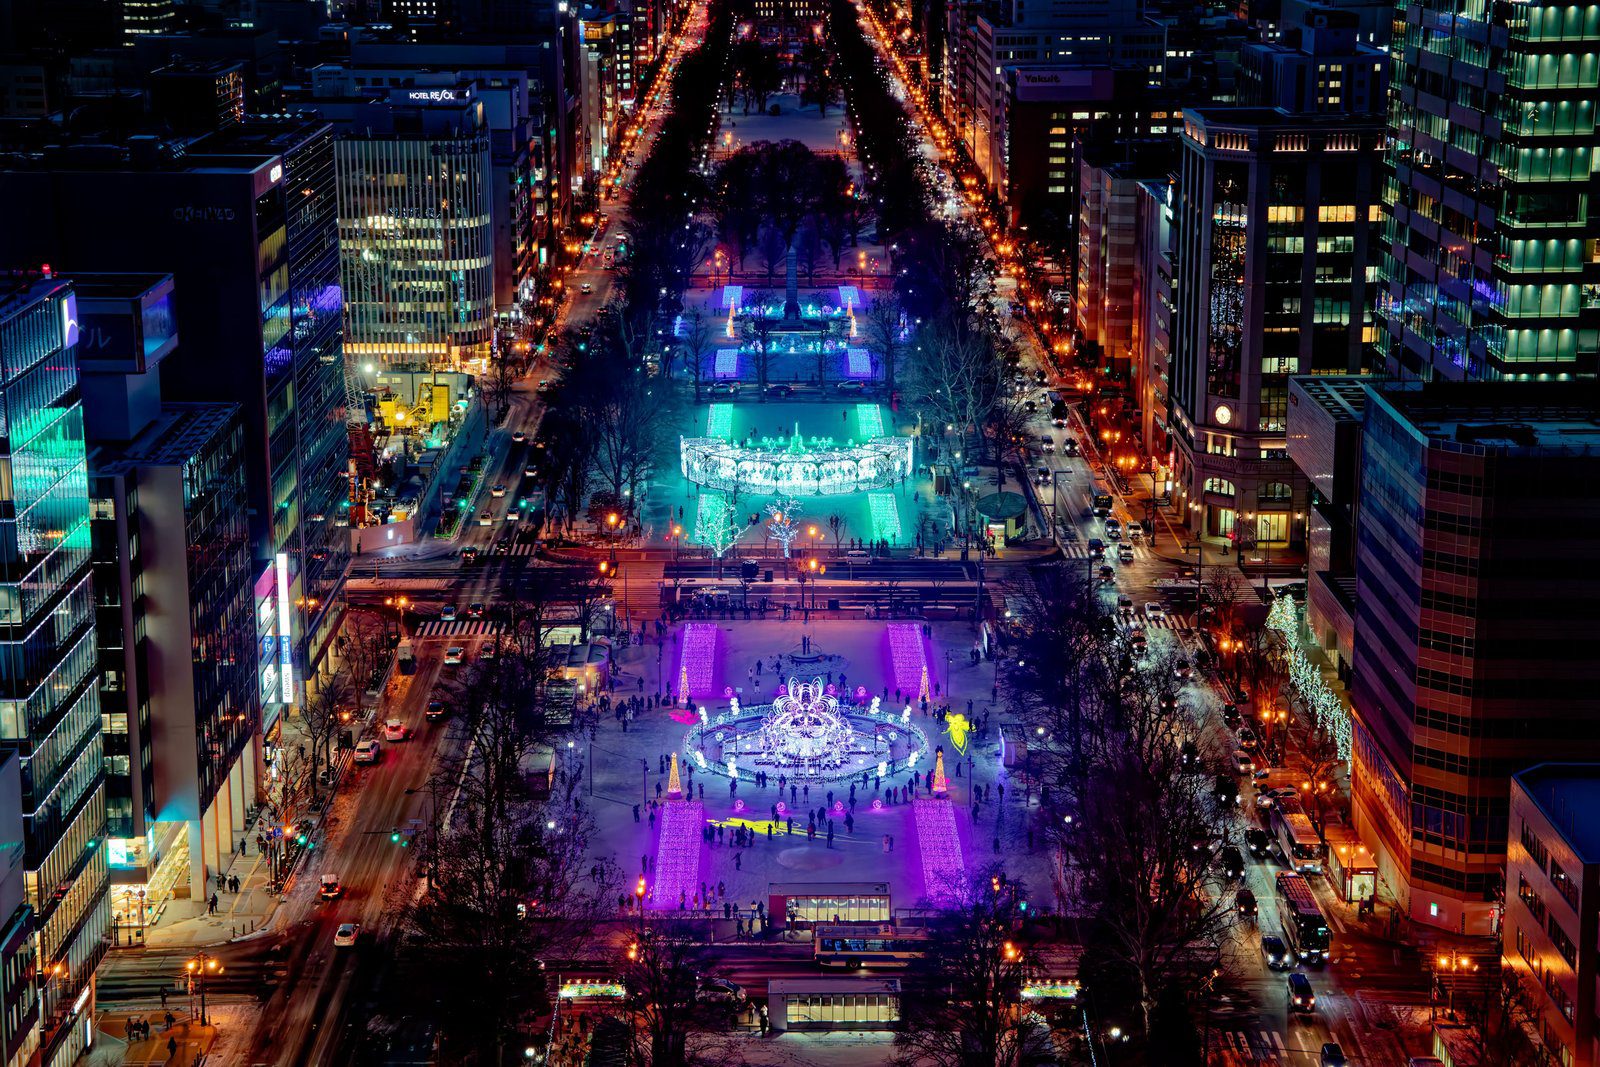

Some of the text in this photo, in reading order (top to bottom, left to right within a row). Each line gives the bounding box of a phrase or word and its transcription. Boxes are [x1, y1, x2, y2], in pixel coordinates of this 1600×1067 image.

[1024, 74, 1060, 83] Yakult
[409, 89, 455, 102] HOTEL RESOL
